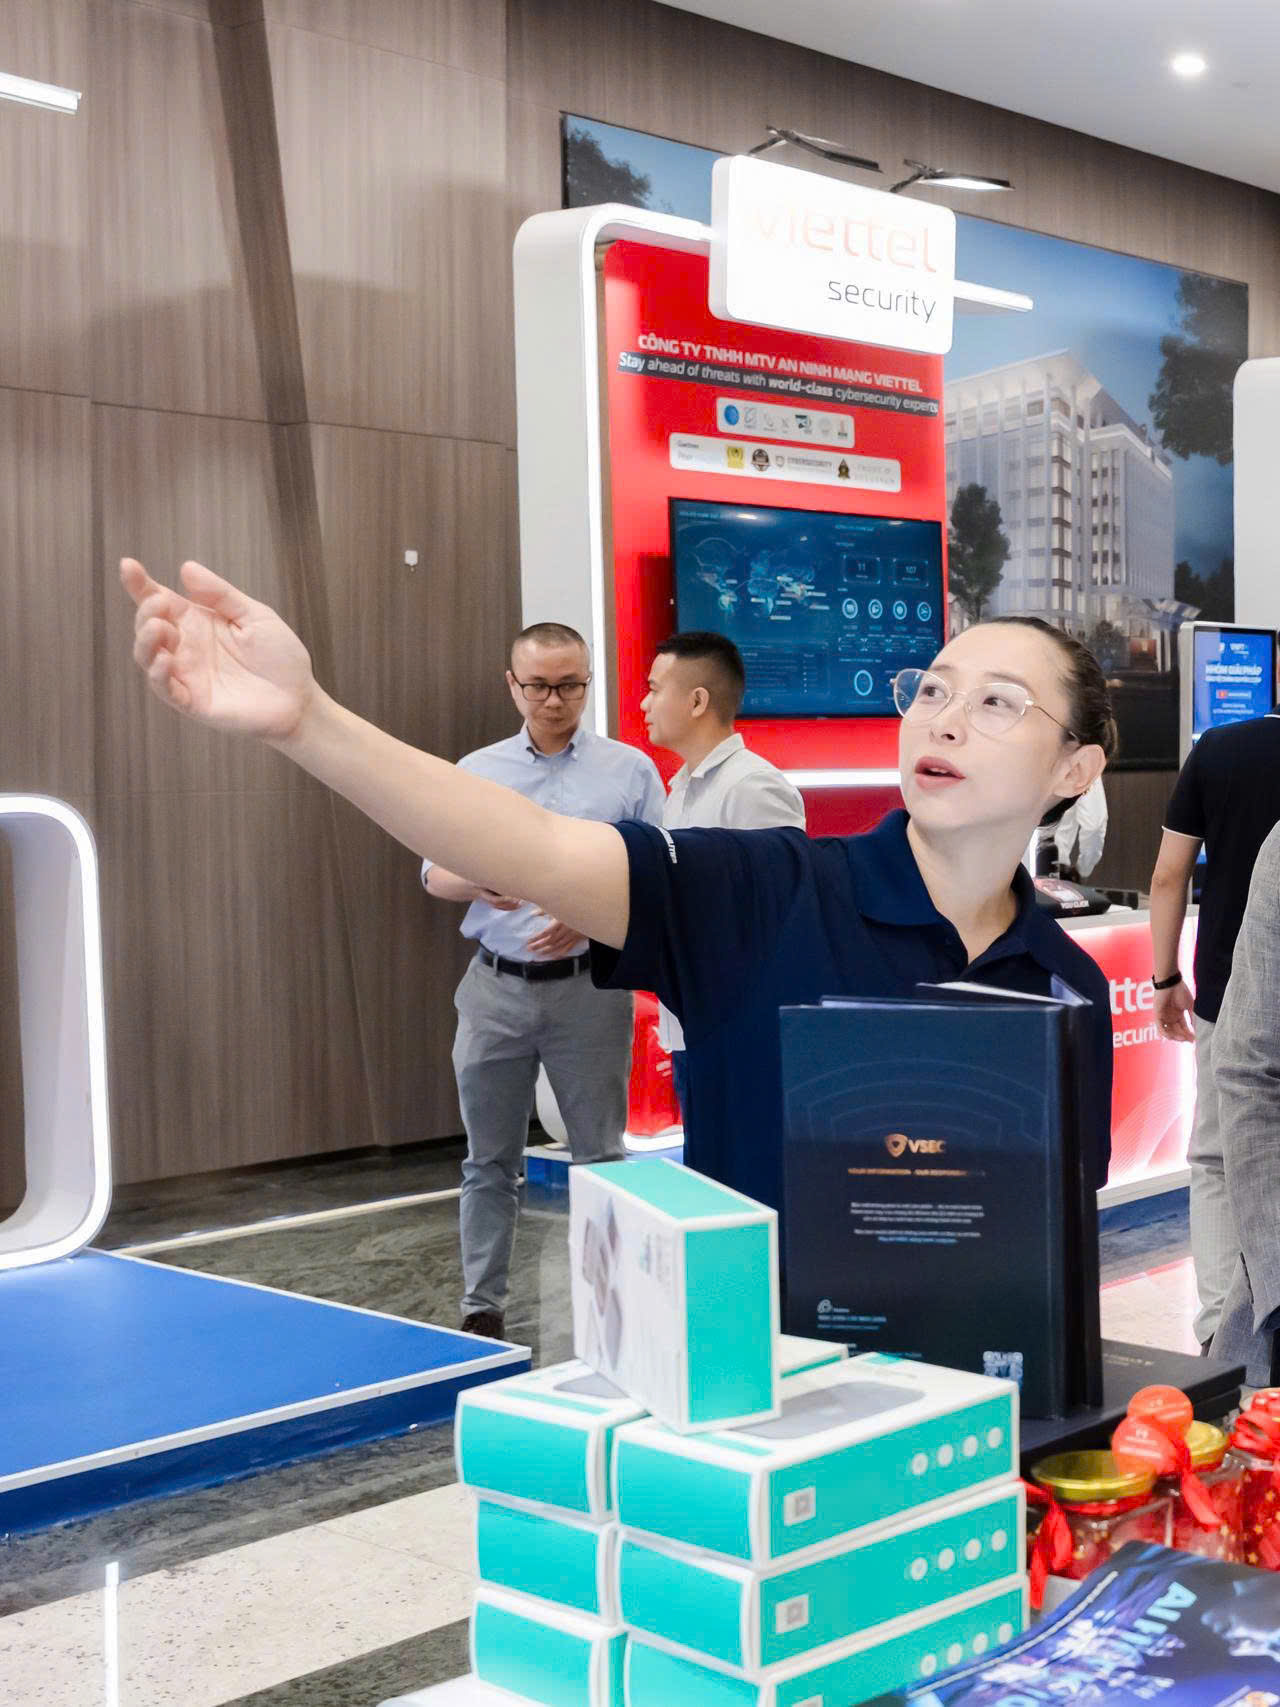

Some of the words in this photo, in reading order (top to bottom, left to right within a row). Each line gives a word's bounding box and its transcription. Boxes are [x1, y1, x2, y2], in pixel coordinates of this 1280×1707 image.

[753, 206, 937, 273] viettel
[828, 281, 936, 324] security
[619, 351, 645, 372] Stay
[647, 358, 684, 376] ahead
[686, 365, 699, 377] of
[701, 366, 740, 384] threats
[743, 373, 766, 387] with
[768, 377, 833, 397] world-class
[835, 386, 903, 410] cybersecurity
[903, 399, 938, 414] experts
[638, 332, 680, 354] CÔNG
[681, 342, 701, 357] TY
[703, 345, 743, 364] TNHH
[745, 352, 776, 369] MTV
[777, 356, 798, 373] AN
[799, 360, 832, 377] NINH
[873, 374, 923, 392] VIETTEL
